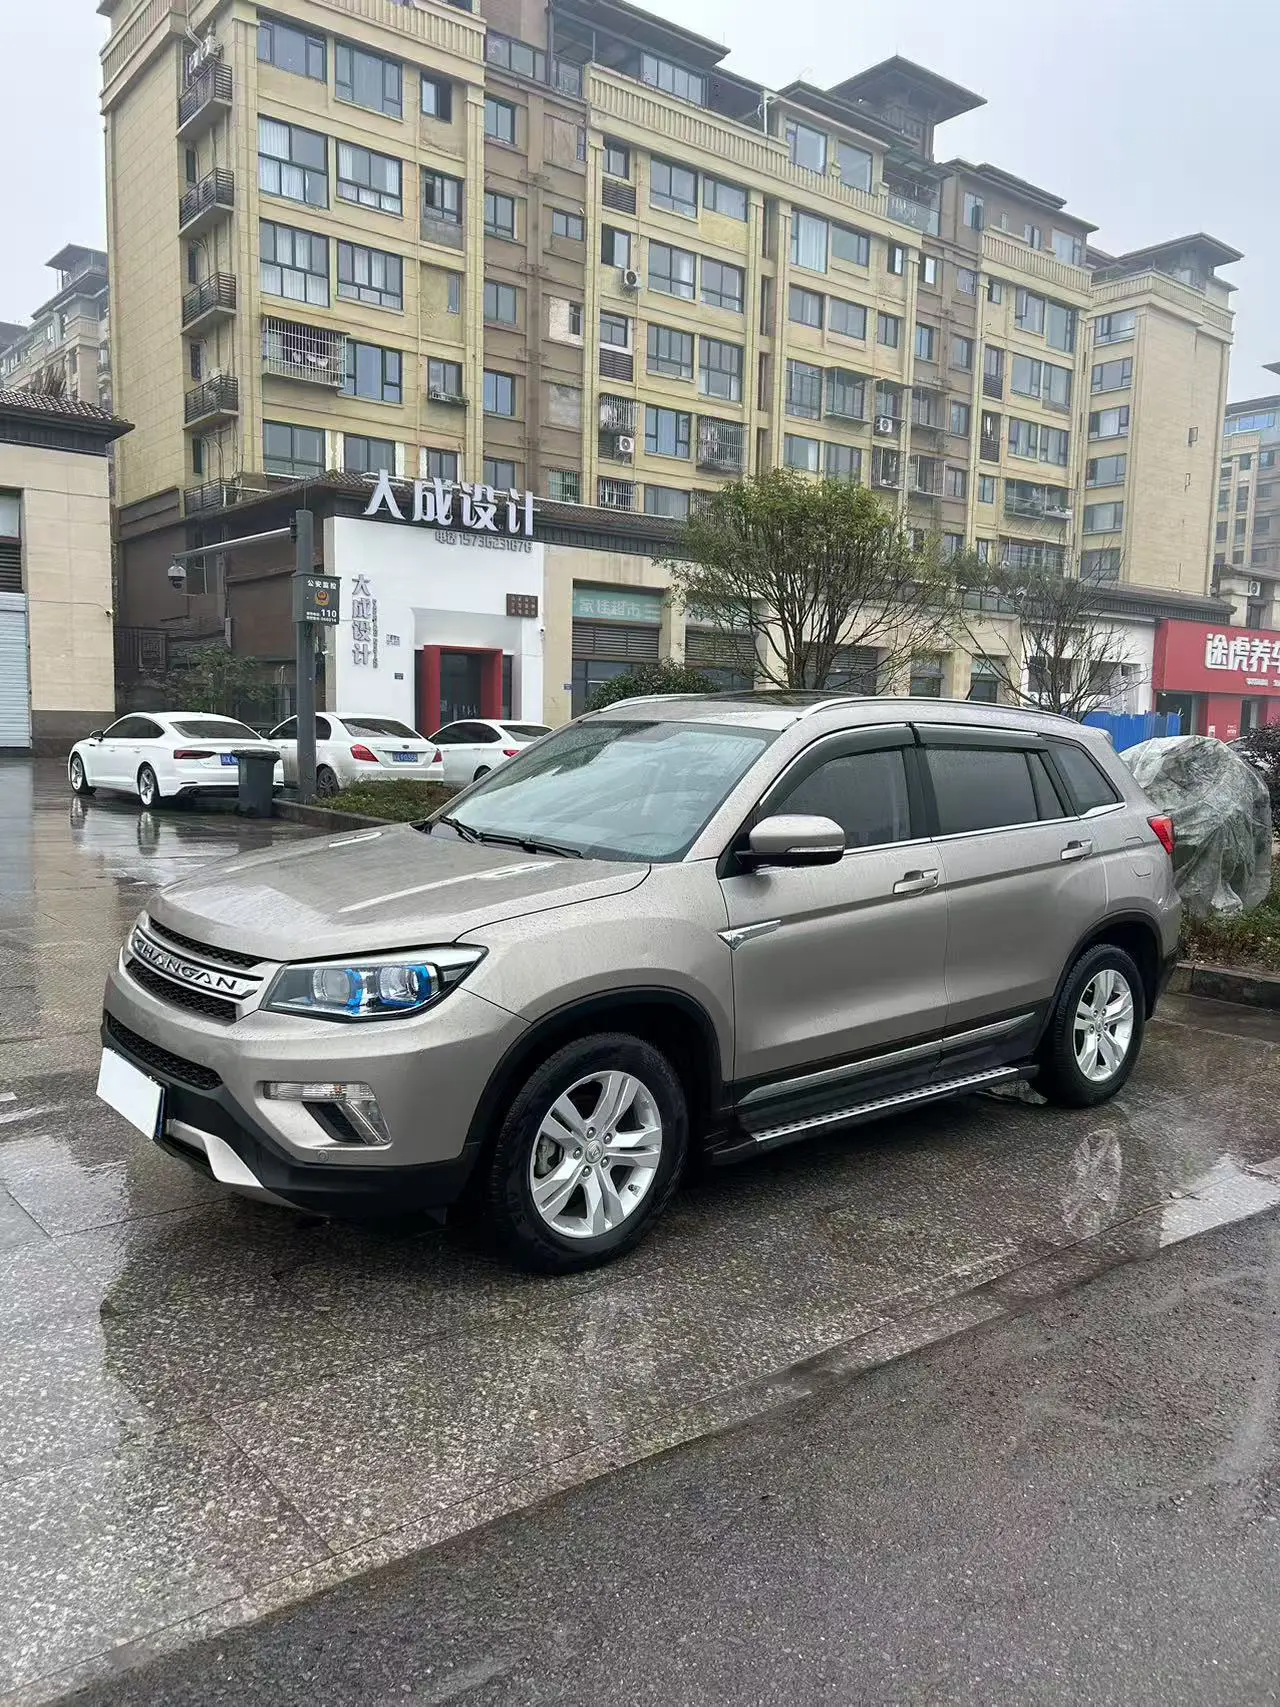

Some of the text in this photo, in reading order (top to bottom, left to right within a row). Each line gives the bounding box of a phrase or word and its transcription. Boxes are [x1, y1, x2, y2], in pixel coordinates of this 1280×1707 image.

[362, 469, 541, 536] 大成设计
[320, 609, 337, 617] 110
[351, 574, 371, 665] 大成设计
[134, 939, 238, 991] CHANGAN
